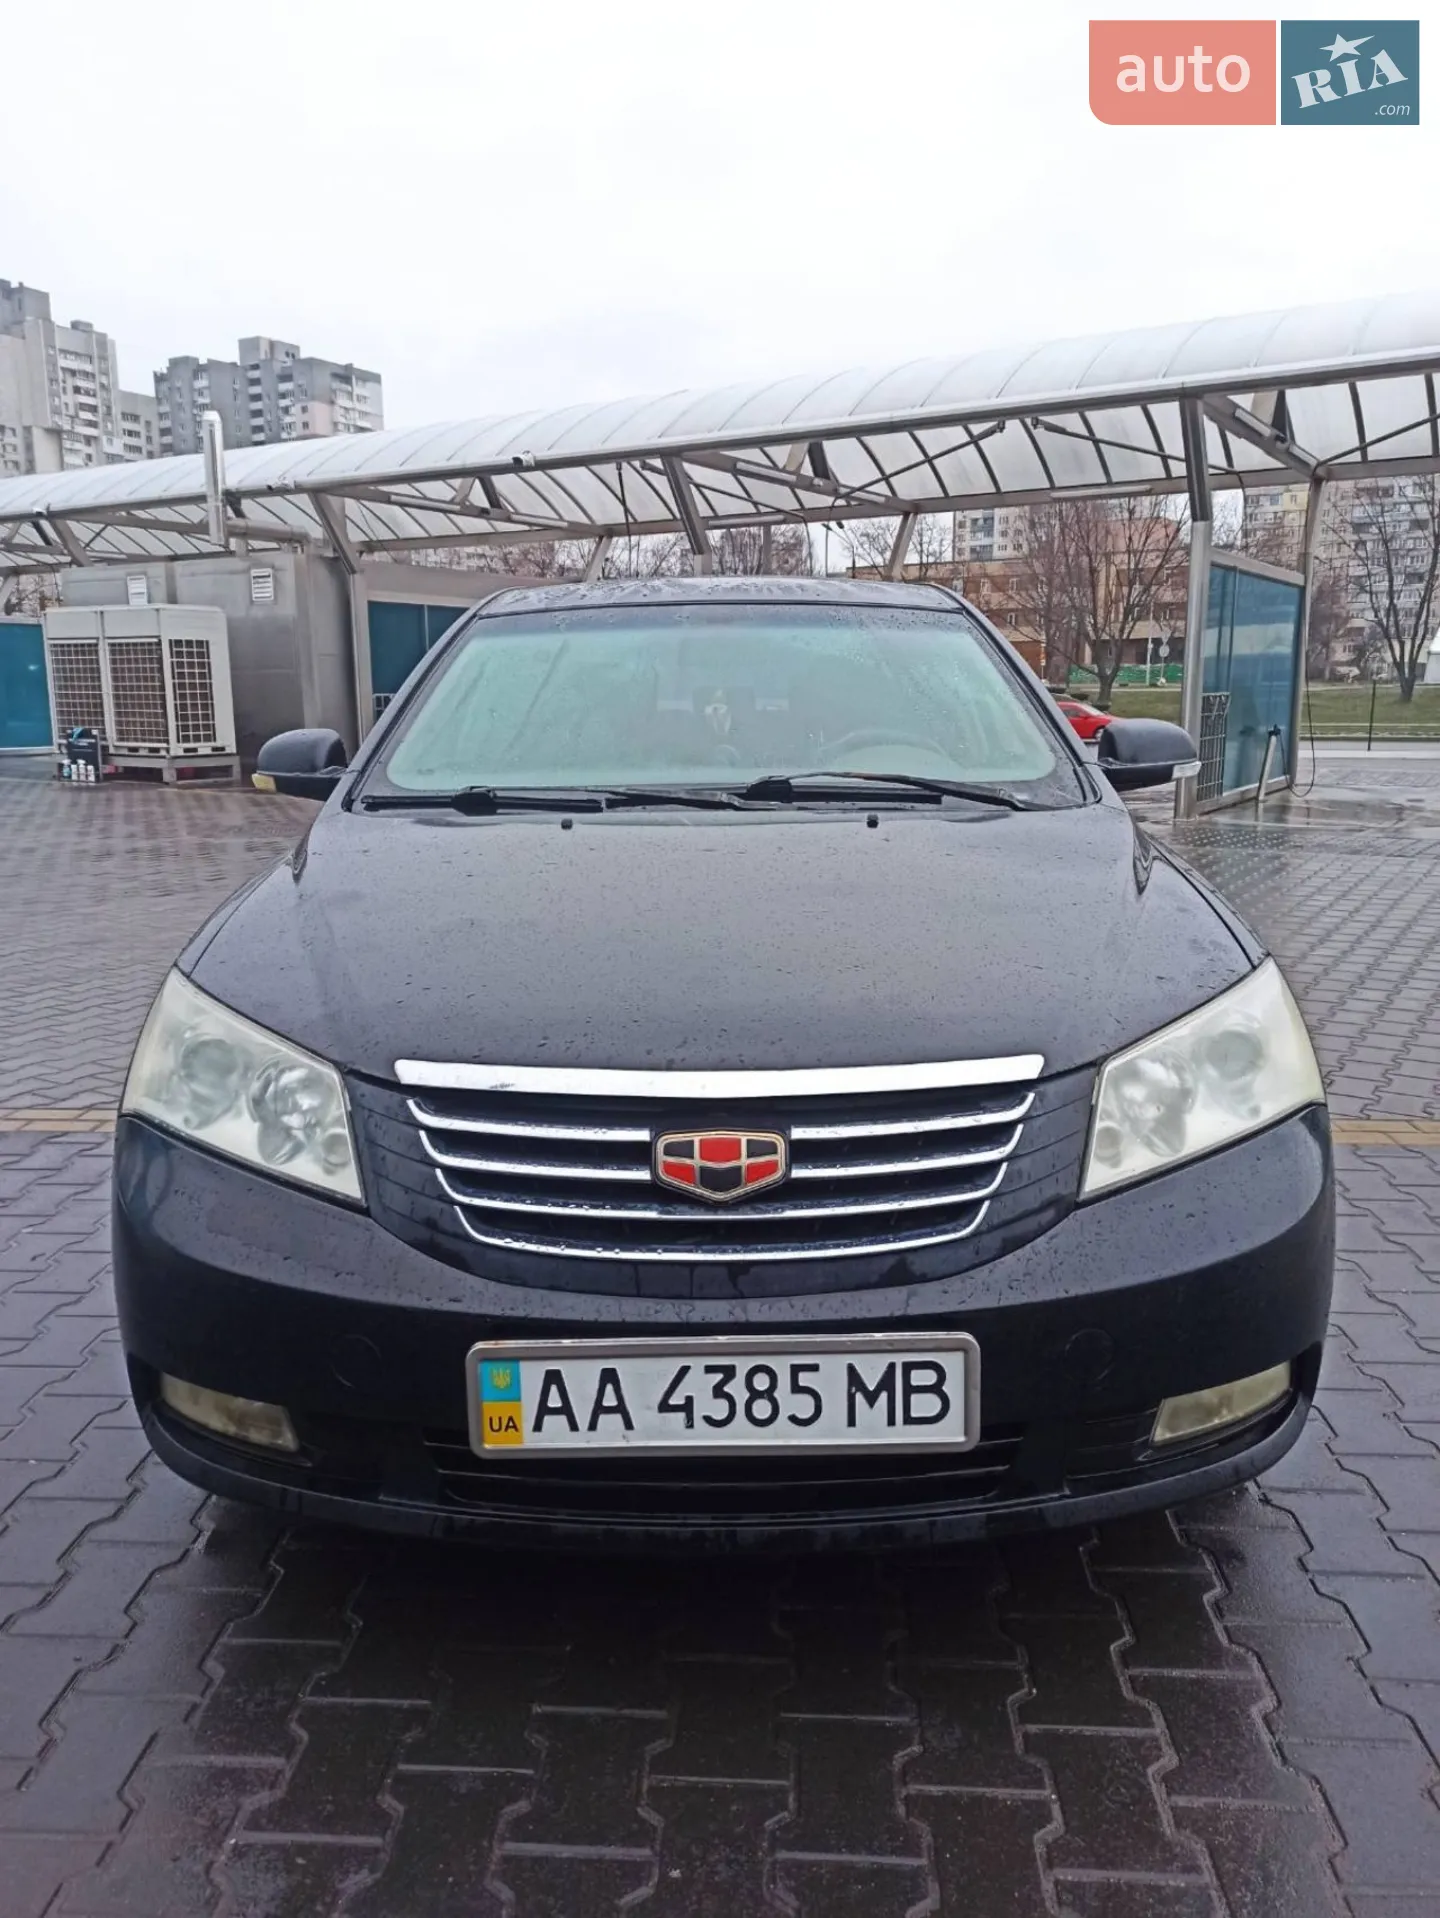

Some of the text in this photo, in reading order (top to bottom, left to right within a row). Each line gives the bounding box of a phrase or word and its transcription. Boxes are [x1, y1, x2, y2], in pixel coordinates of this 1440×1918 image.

[531, 1360, 951, 1433] AA 4385 MB
[488, 1415, 520, 1434] UA
